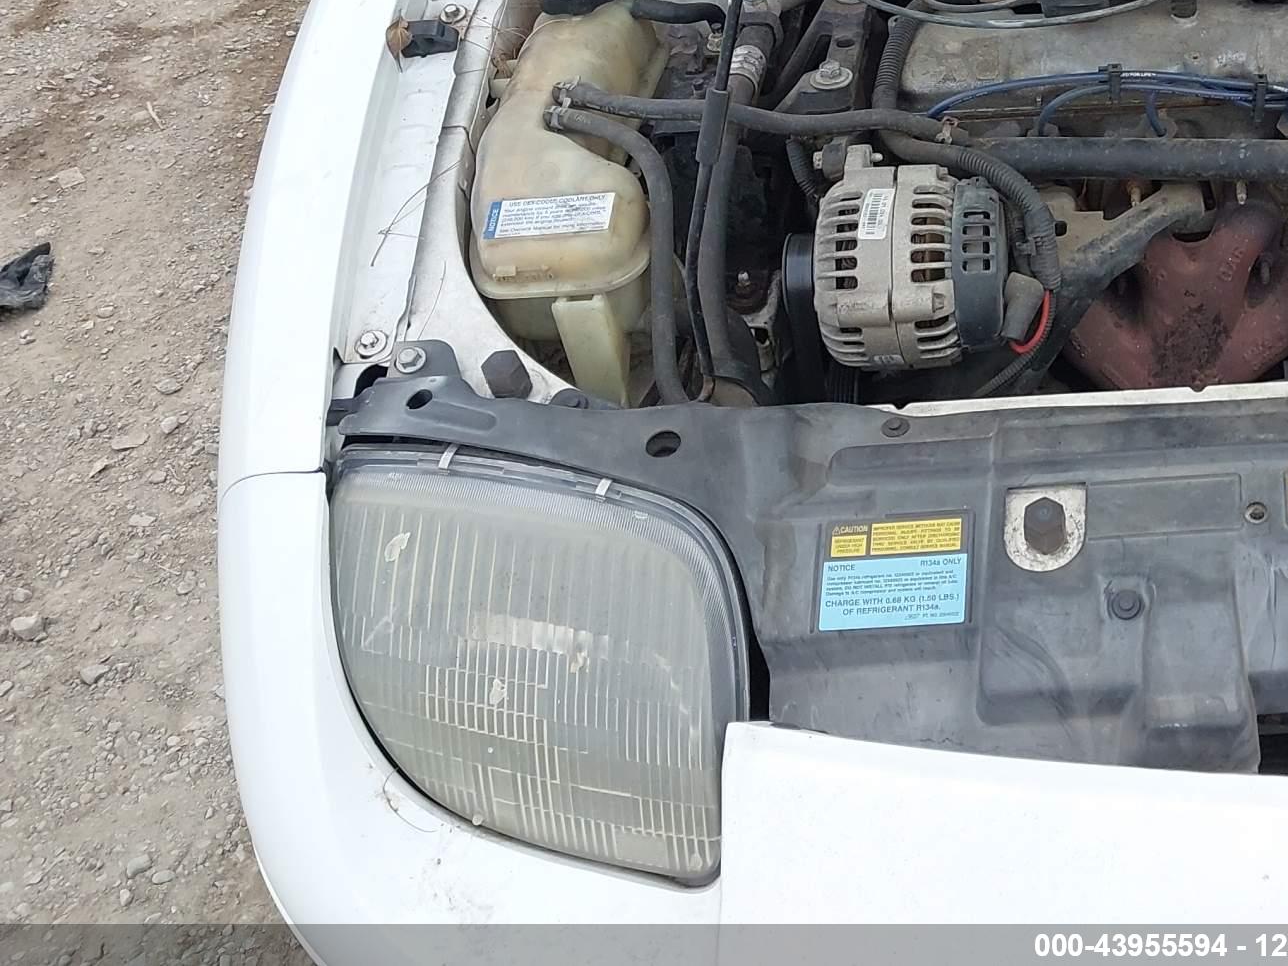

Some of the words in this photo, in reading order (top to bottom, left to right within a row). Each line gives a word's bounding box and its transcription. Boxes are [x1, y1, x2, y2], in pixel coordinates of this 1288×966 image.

[488, 209, 499, 232] NOTICE
[839, 525, 868, 534] CAUTION
[942, 557, 961, 565] ONLY
[827, 564, 856, 572] NOTICE
[825, 598, 860, 608] CHARGE
[862, 597, 883, 606] WITH
[903, 595, 916, 603] KG
[938, 593, 960, 603] LBS.)
[856, 604, 913, 614] REFRIGERANT
[916, 603, 941, 611] R134a.
